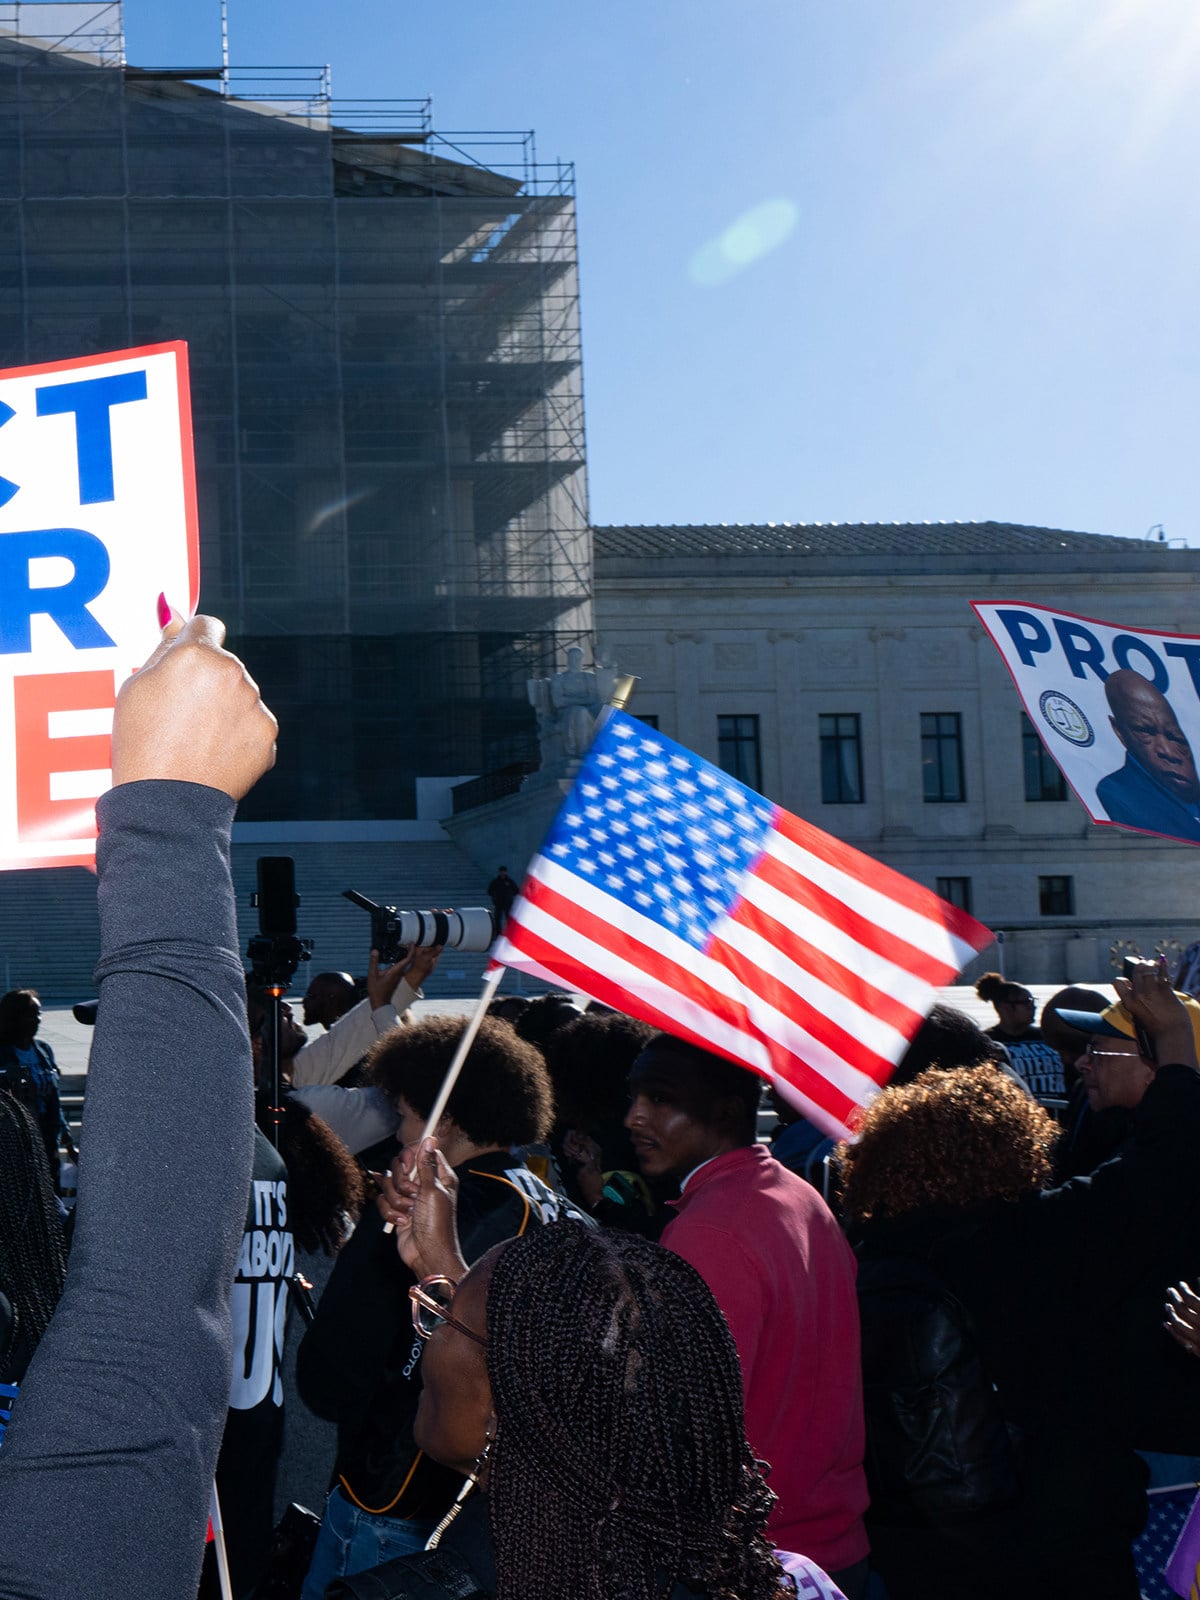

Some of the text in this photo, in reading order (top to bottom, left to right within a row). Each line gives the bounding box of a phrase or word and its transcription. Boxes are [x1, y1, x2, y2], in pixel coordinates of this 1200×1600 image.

[1012, 1055, 1064, 1076] OTERS
[1023, 1074, 1066, 1093] TTER
[253, 1180, 287, 1227] IT'S
